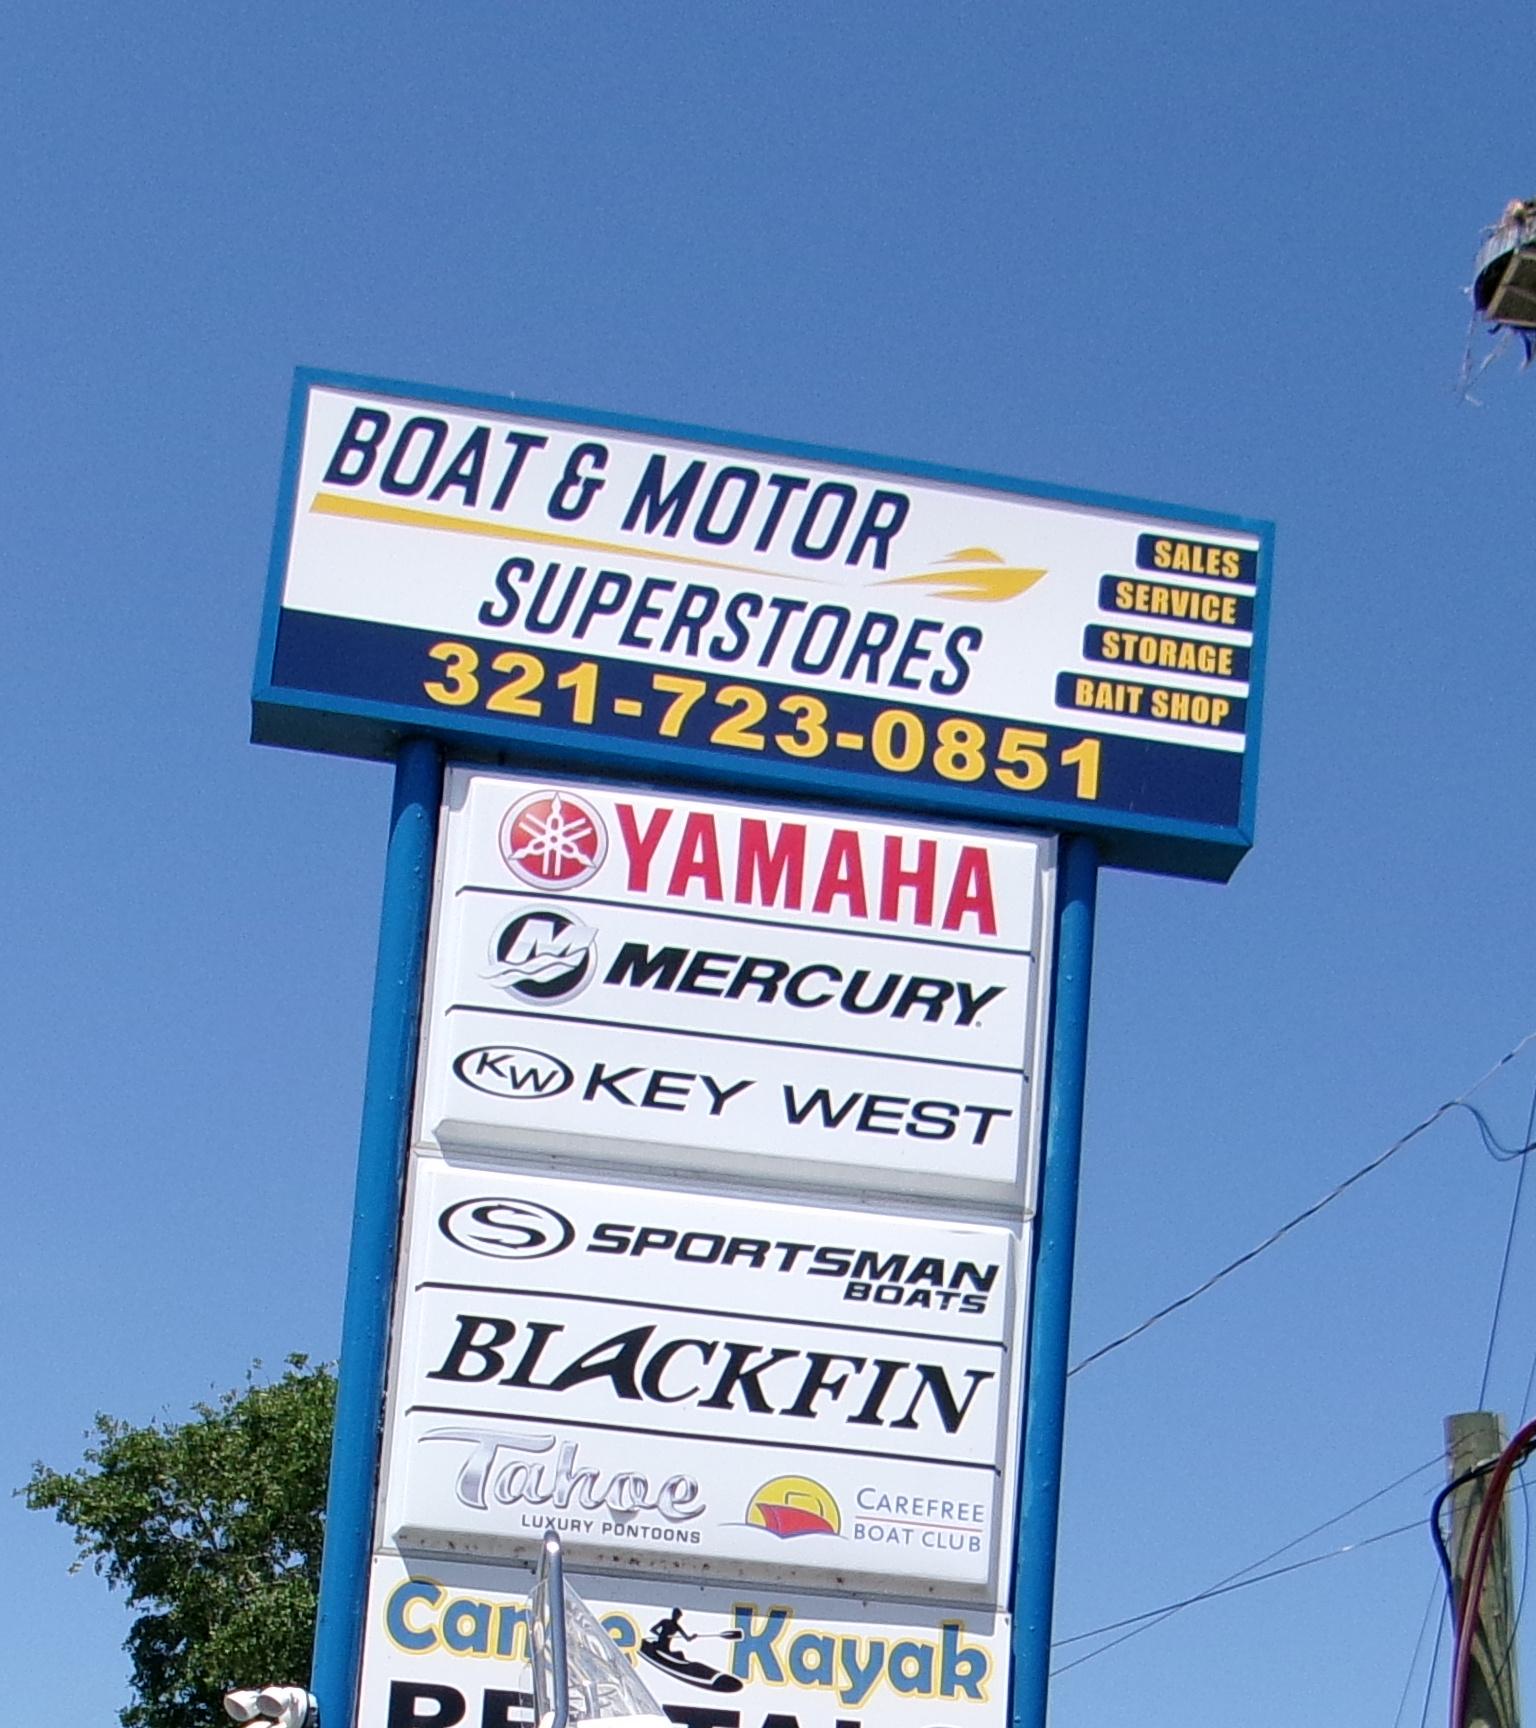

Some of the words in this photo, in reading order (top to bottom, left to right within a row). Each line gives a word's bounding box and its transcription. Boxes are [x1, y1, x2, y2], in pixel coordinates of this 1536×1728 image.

[322, 406, 548, 511] BOAT
[547, 442, 609, 521] &
[620, 455, 910, 570] MOTOR
[1153, 540, 1240, 579] SALES
[478, 556, 983, 696] SUPERSTORES
[1115, 581, 1237, 625] SERVICE
[1101, 630, 1233, 676] STORAGE
[423, 641, 1103, 800] 321-723-0851
[1074, 679, 1144, 715] BAIT
[1151, 690, 1230, 726] SHOP
[615, 803, 998, 936] YAMAHA
[604, 942, 1007, 1026] MERCURY
[475, 1051, 560, 1093] KW
[582, 1062, 756, 1116] KEY
[782, 1084, 1013, 1145] WEST
[586, 1223, 1000, 1292] SPORTSMAN
[843, 1281, 991, 1315] BOATS
[426, 1314, 994, 1434] BLACKFIN
[418, 1427, 706, 1520] Tahoe
[857, 1487, 984, 1523] CAREFREE
[521, 1514, 594, 1534] LUXURY
[602, 1522, 701, 1544] PONTOONS
[854, 1523, 914, 1545] BOAT
[922, 1531, 981, 1553] CLUB
[730, 1603, 992, 1707] Kayak
